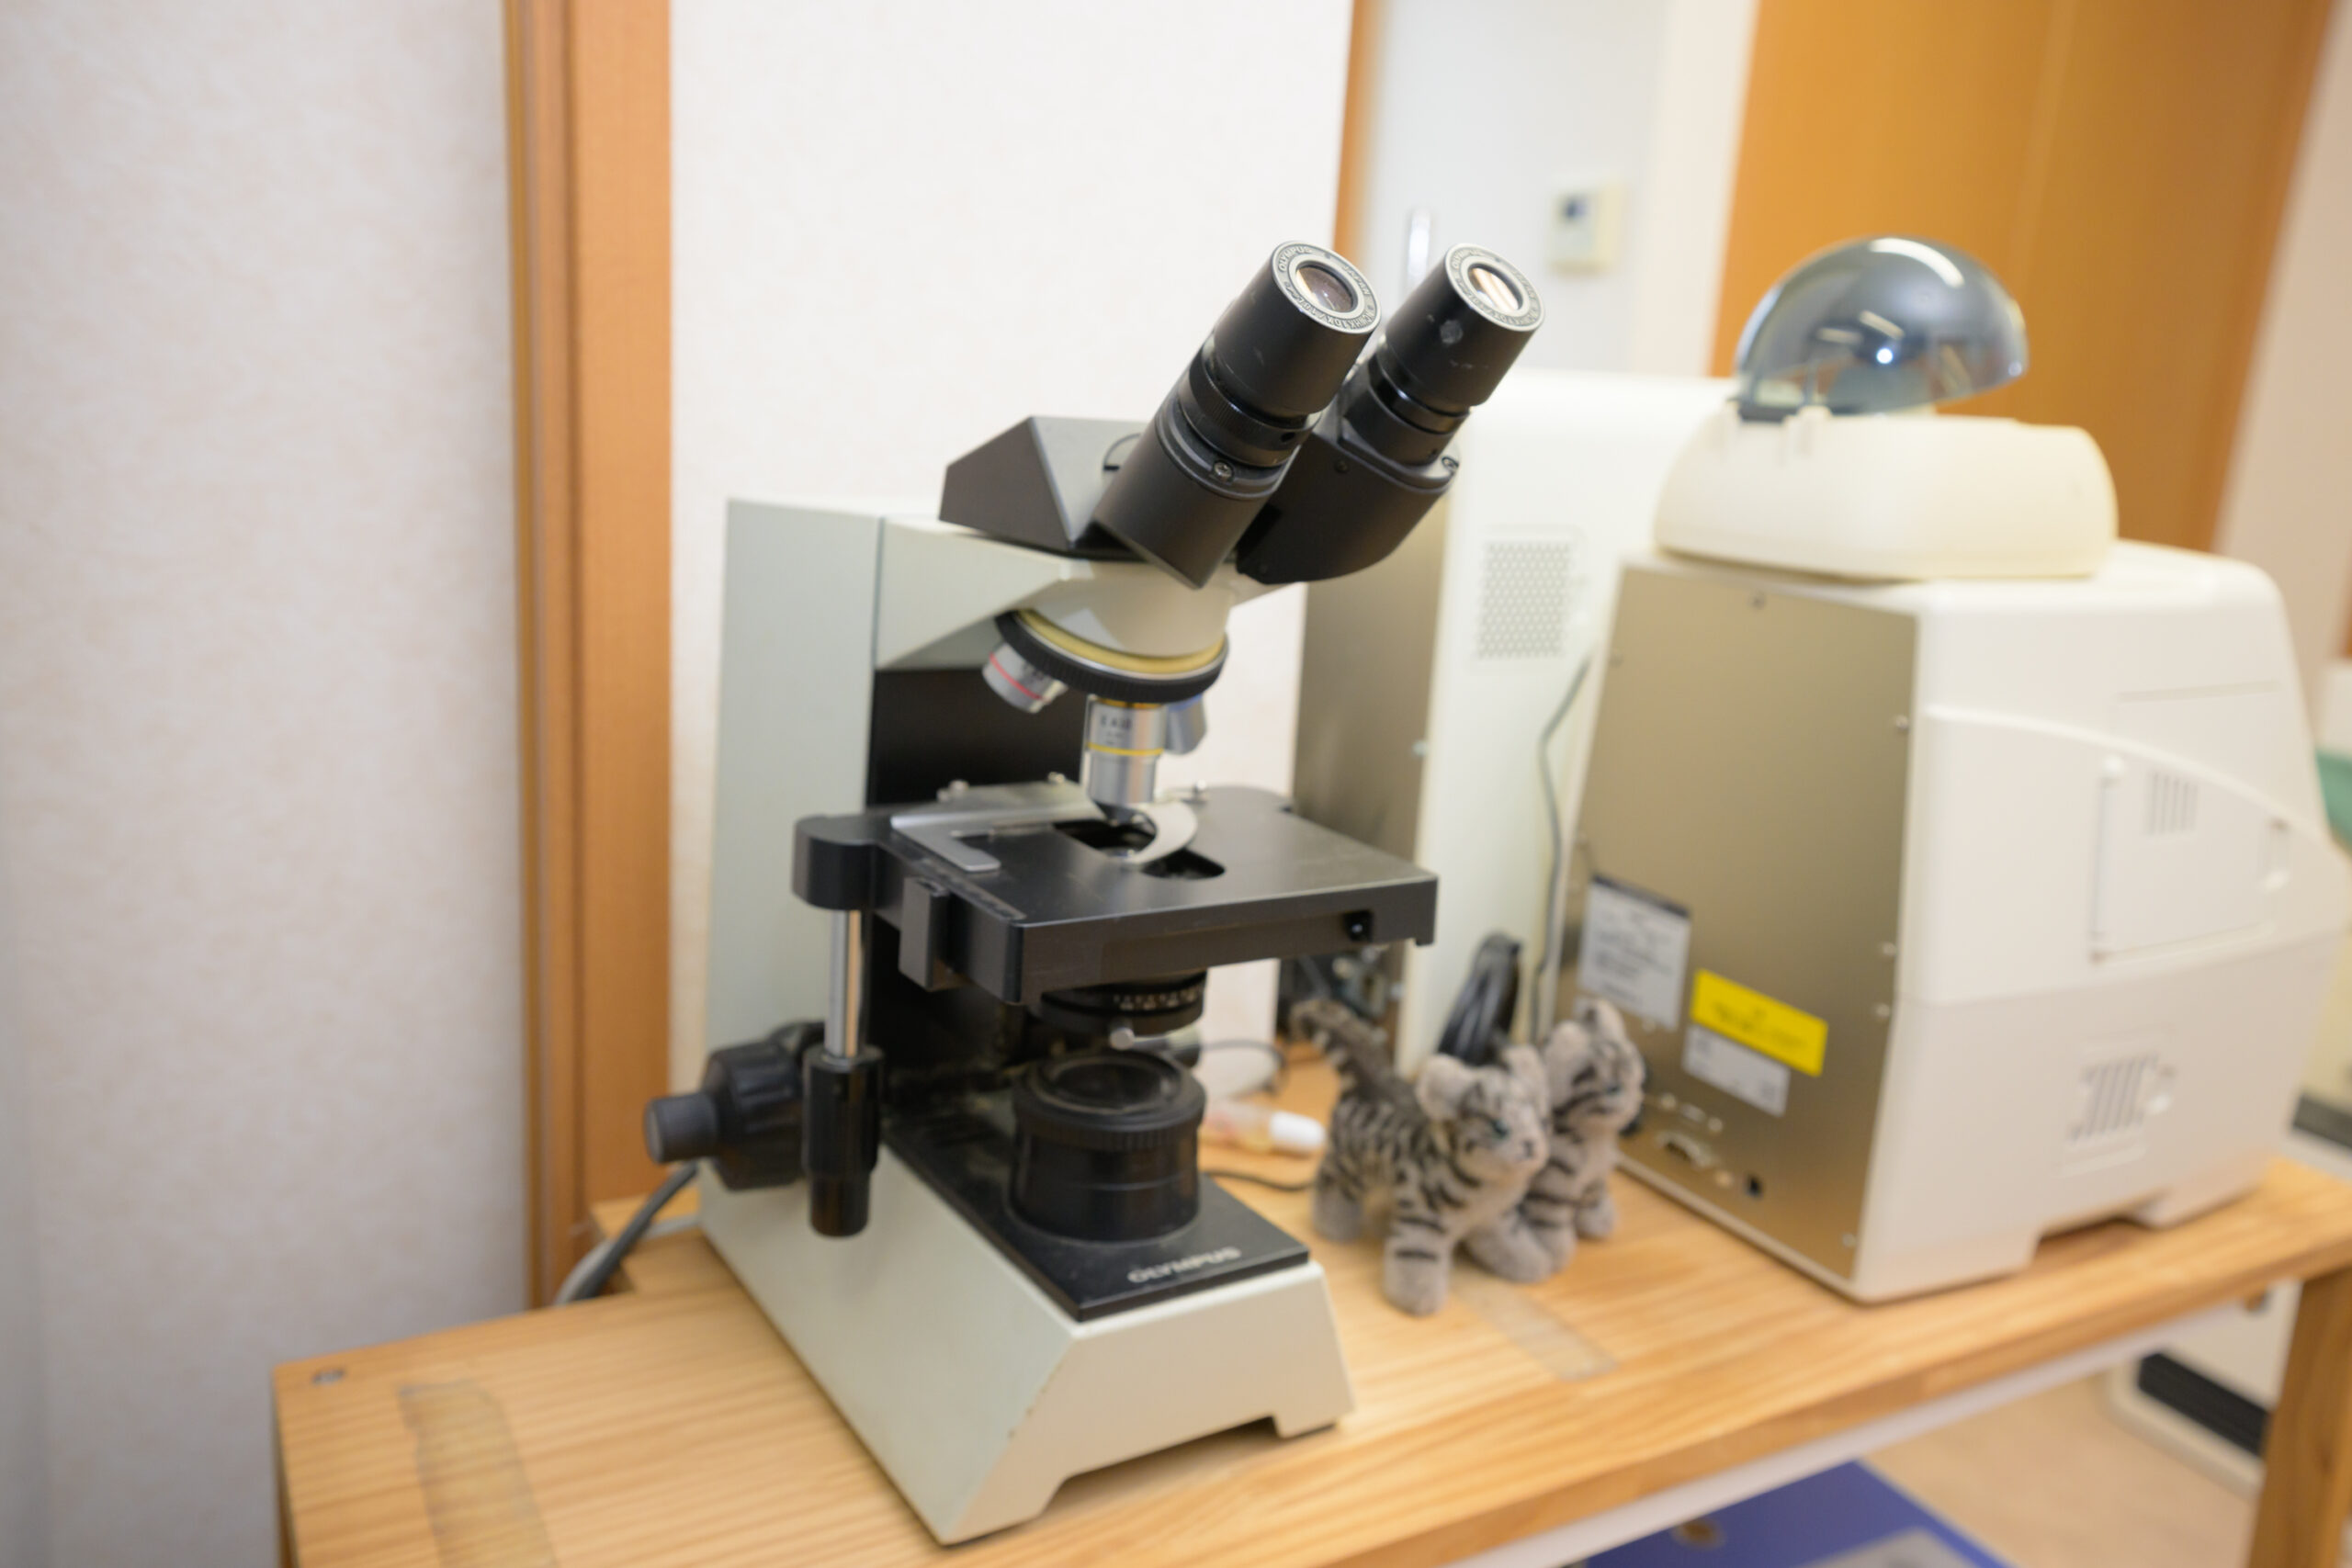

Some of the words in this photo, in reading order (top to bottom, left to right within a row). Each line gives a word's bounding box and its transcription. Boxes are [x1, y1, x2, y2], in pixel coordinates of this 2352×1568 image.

[1278, 245, 1313, 272] OLYMPUS
[1342, 265, 1371, 296] JAPAN
[1126, 1247, 1242, 1282] OLYMPUS
